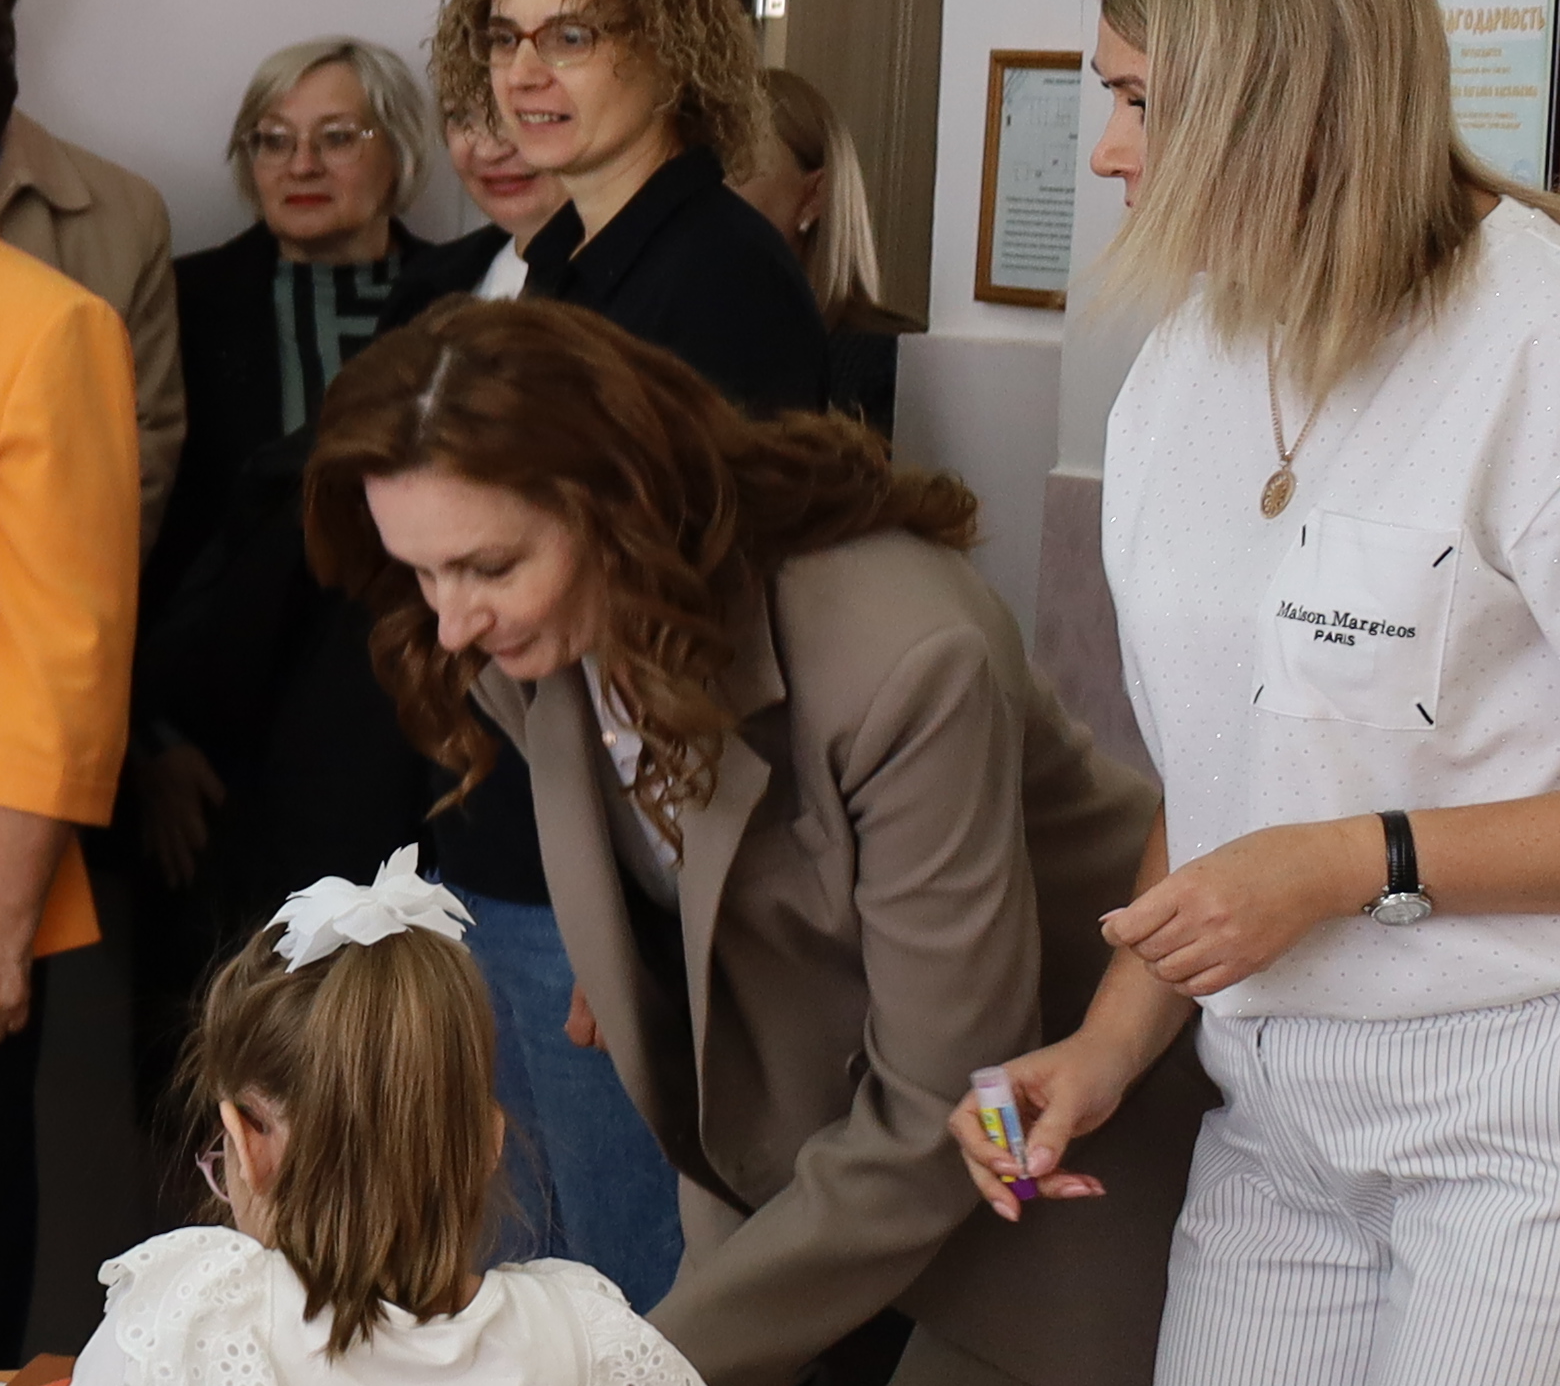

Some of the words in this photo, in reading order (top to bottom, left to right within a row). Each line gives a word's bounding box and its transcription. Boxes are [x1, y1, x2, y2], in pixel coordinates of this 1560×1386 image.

[1445, 6, 1546, 35] АГОДАРНОСТЬ
[1276, 600, 1327, 625] Maison
[1314, 629, 1355, 646] PARIS
